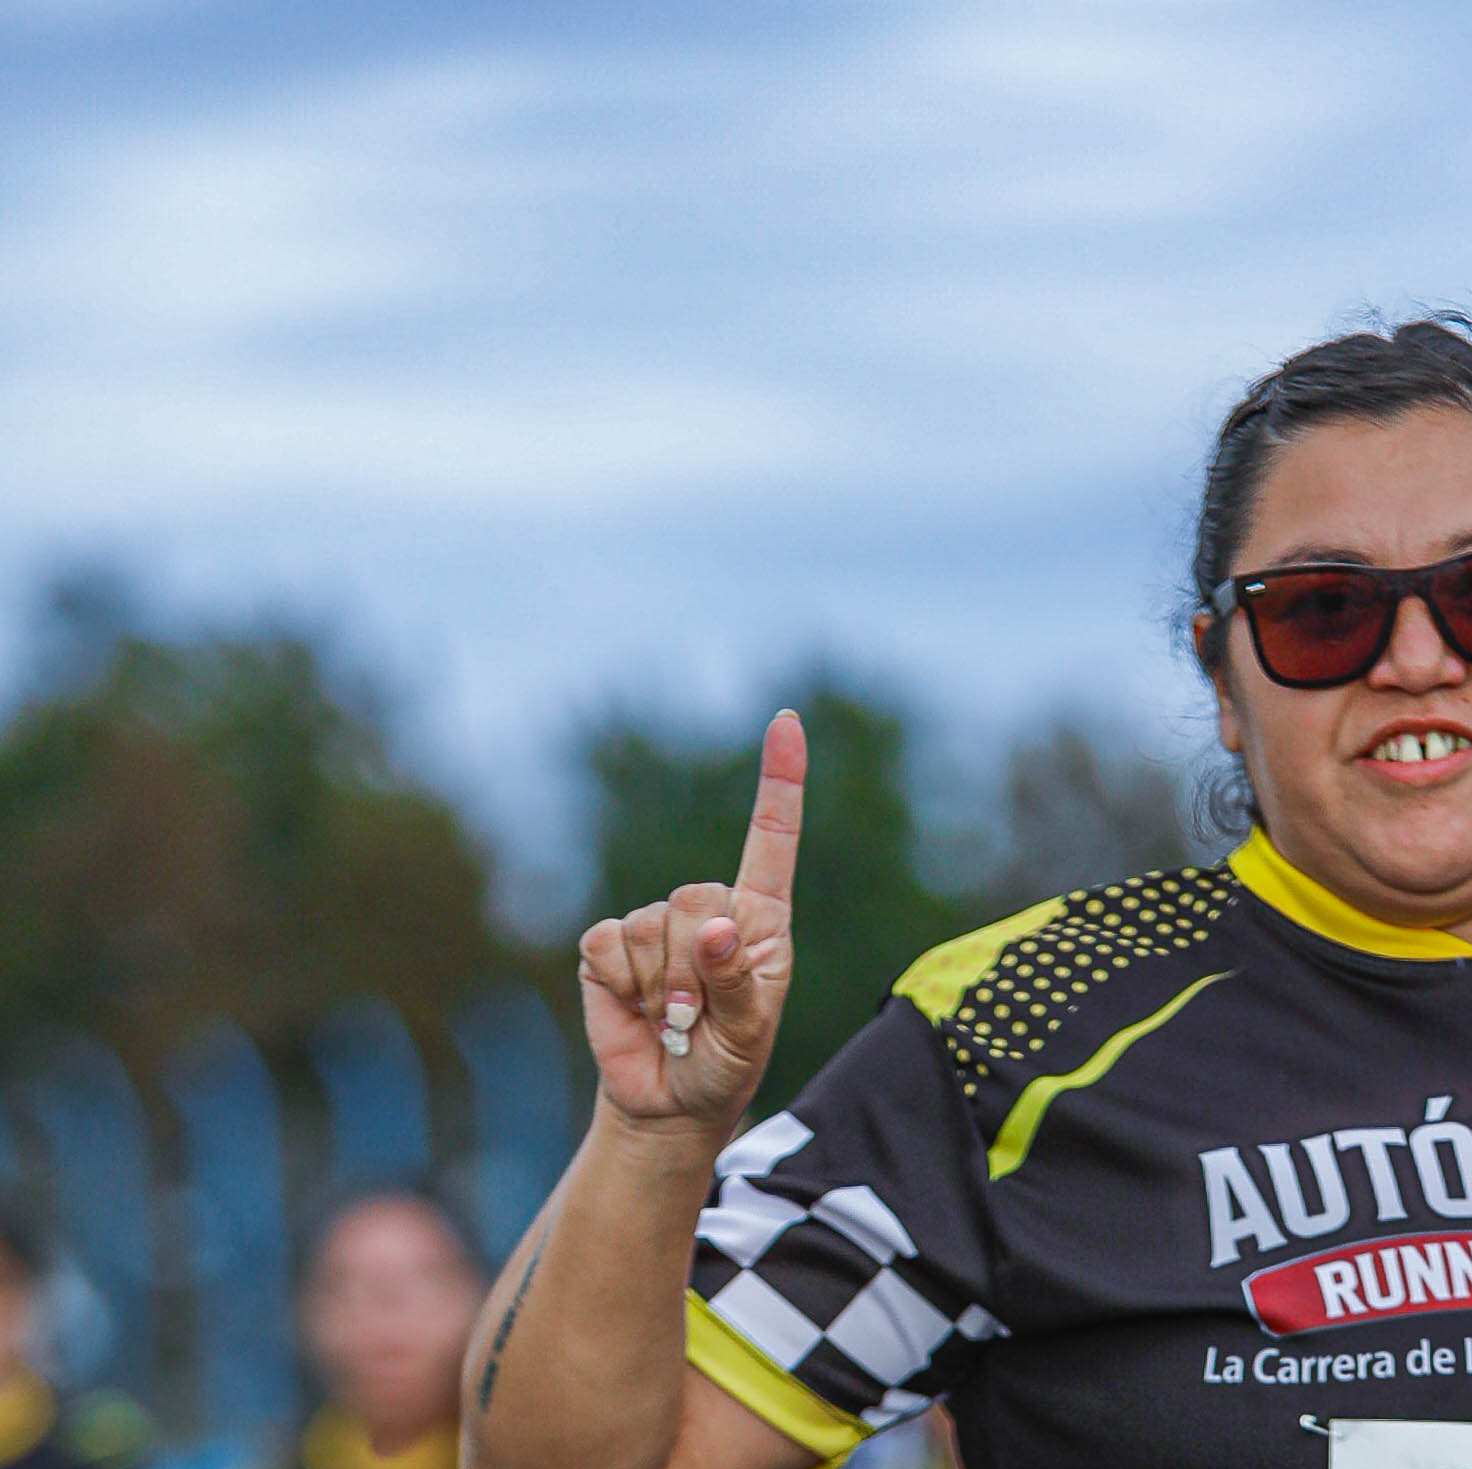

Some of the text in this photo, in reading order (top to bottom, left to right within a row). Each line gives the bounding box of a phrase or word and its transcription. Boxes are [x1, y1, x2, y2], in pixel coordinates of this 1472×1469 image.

[1203, 1346, 1245, 1384] La
[1252, 1347, 1396, 1384] Carrera
[1405, 1337, 1456, 1376] de
